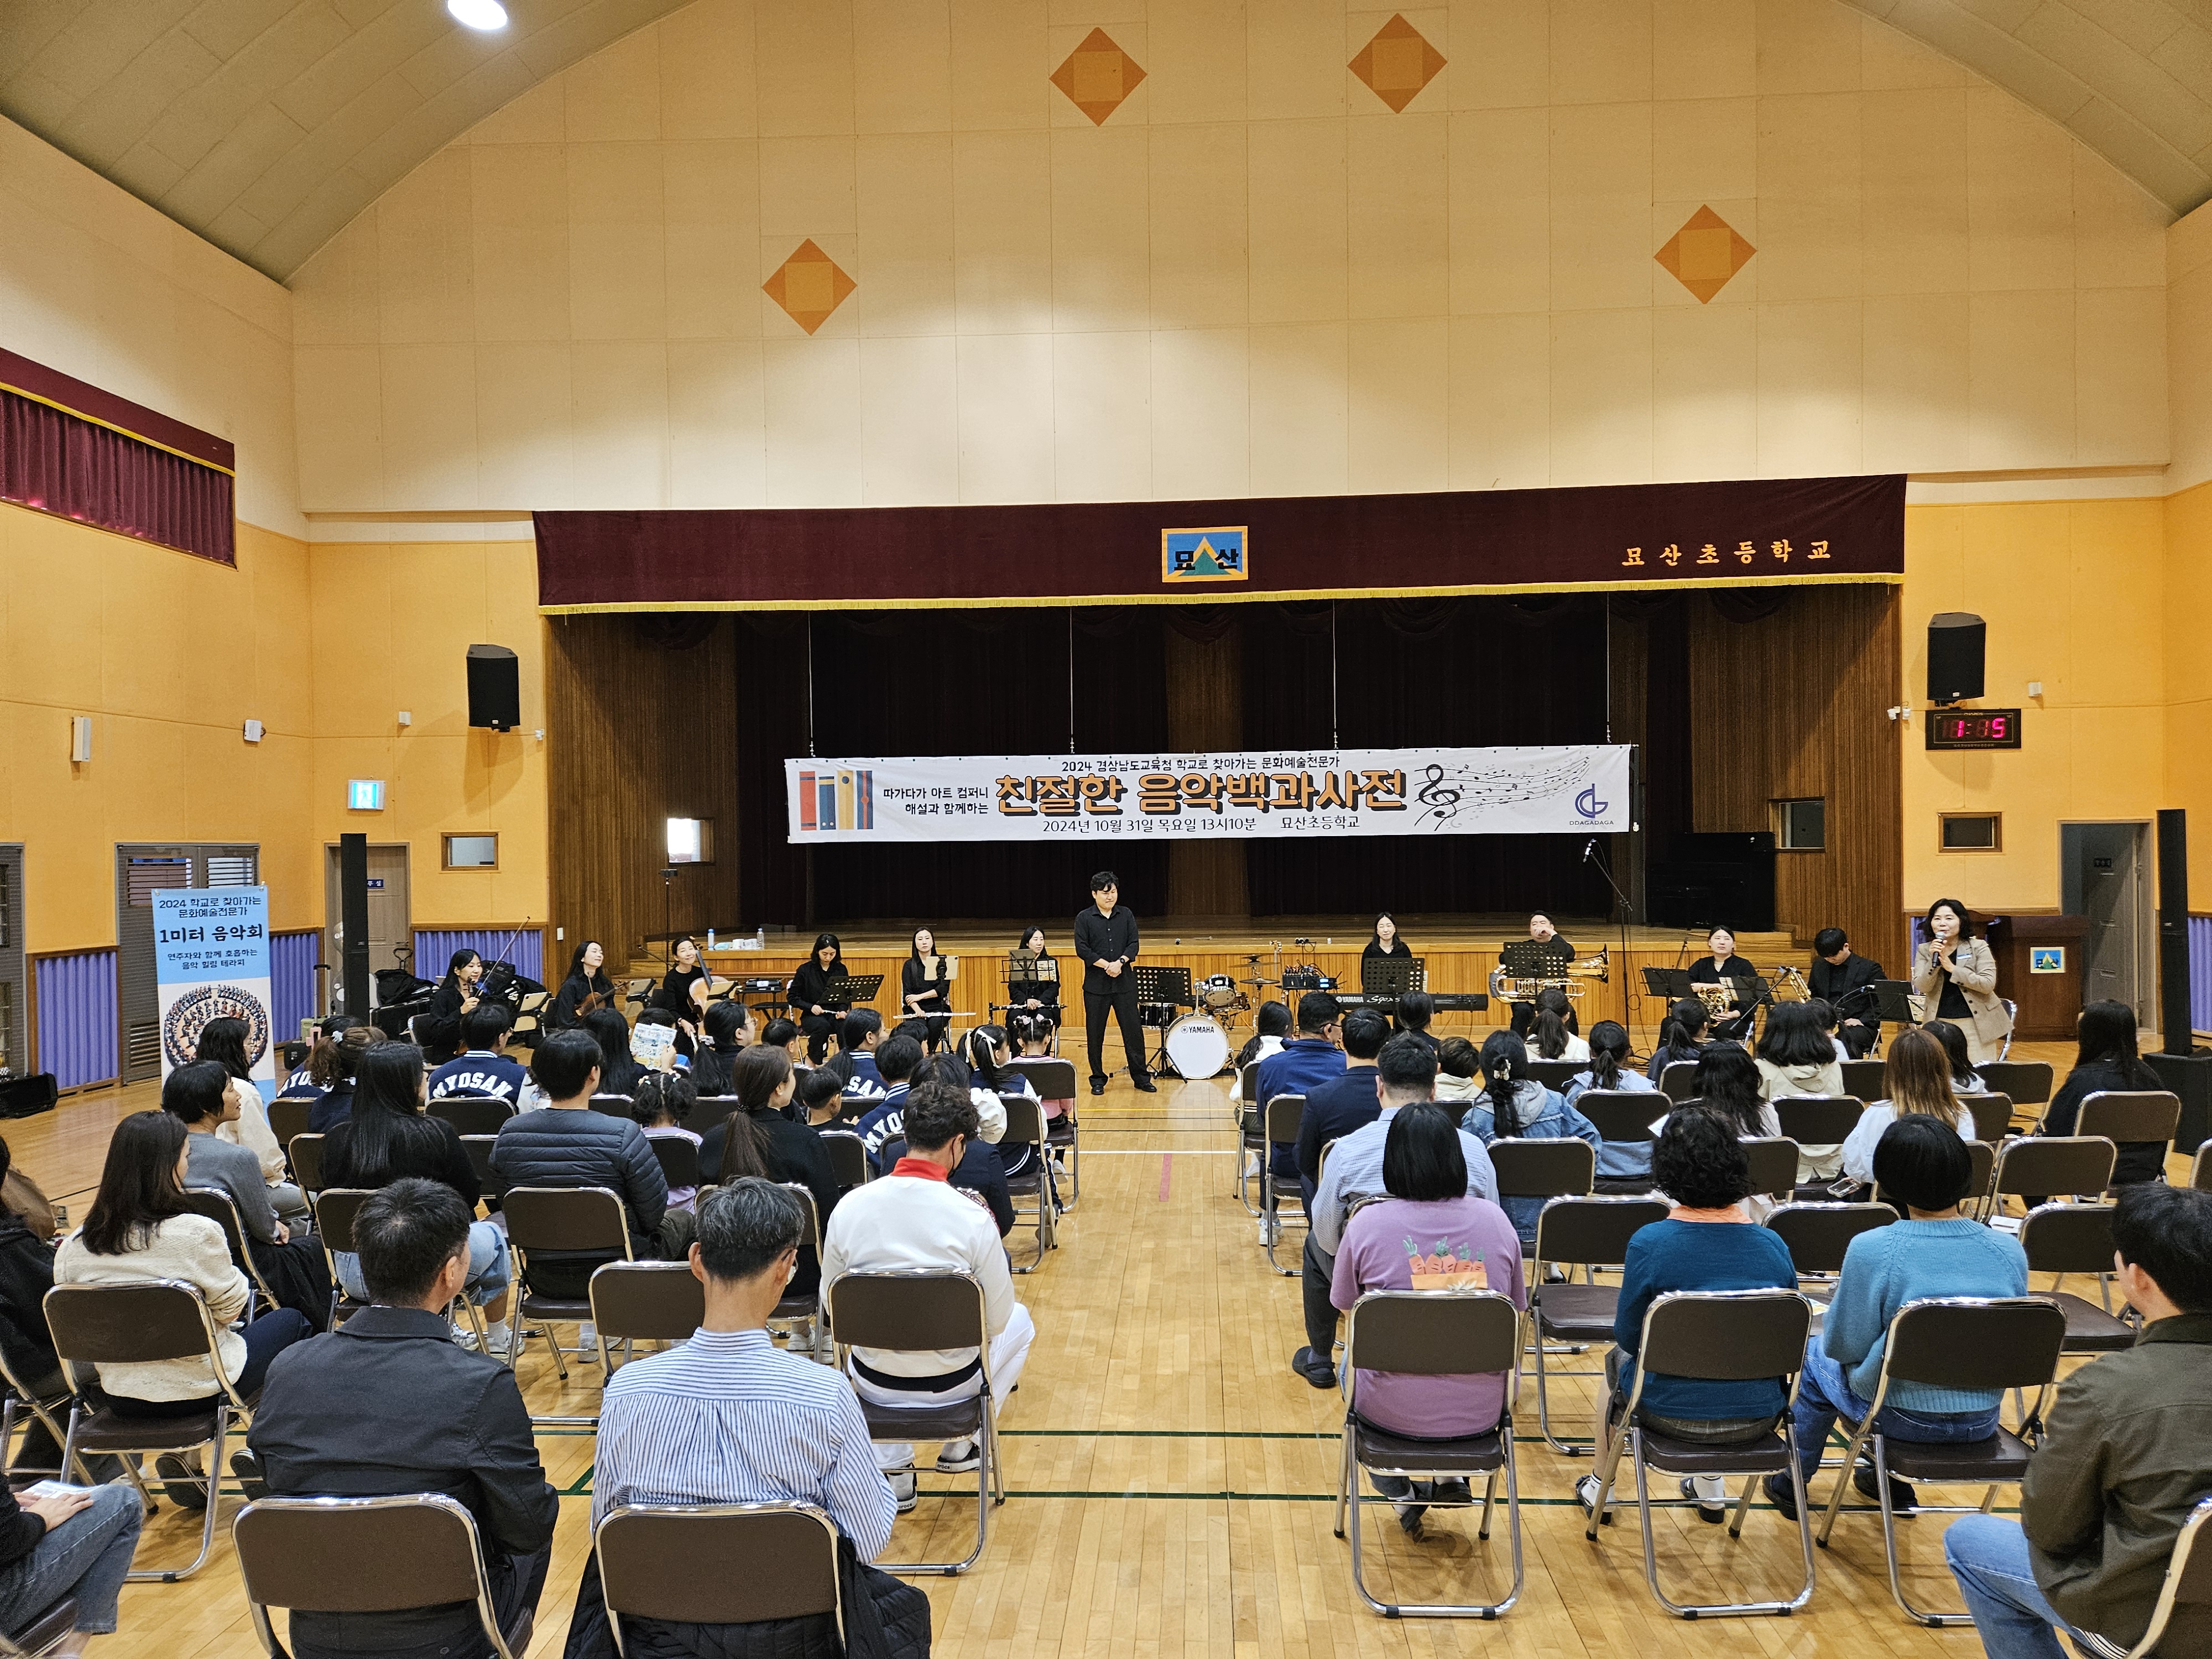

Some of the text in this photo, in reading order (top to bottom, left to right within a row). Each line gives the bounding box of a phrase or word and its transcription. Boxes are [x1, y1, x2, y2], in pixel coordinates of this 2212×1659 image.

[1173, 548, 1239, 571] 묘산
[1621, 539, 1832, 567] 묘산초등학교
[1957, 718, 2005, 738] 1:15
[1061, 756, 1340, 772] 2024 경상남도교육청 학교로 찾아가는 문화예술전문가
[883, 787, 988, 799] 따가다가 아트 컴퍼니
[995, 769, 1408, 817] 친절한 음악백과사전
[905, 802, 989, 815] 해설과 함께하는
[1042, 815, 1360, 833] 2024년 10월 31일 목요일 13시10분 묘산초등학교
[159, 896, 262, 909] 2024 학교로 찾아가는
[179, 907, 248, 918] 문화예술전문가
[160, 924, 263, 943] 1미터 음악회
[168, 949, 258, 961] 연주자와 함께 호흡하는
[182, 959, 245, 969] 음악 힐링 테라피
[432, 1072, 513, 1098] MYOSAN
[863, 1109, 905, 1154] MYO
